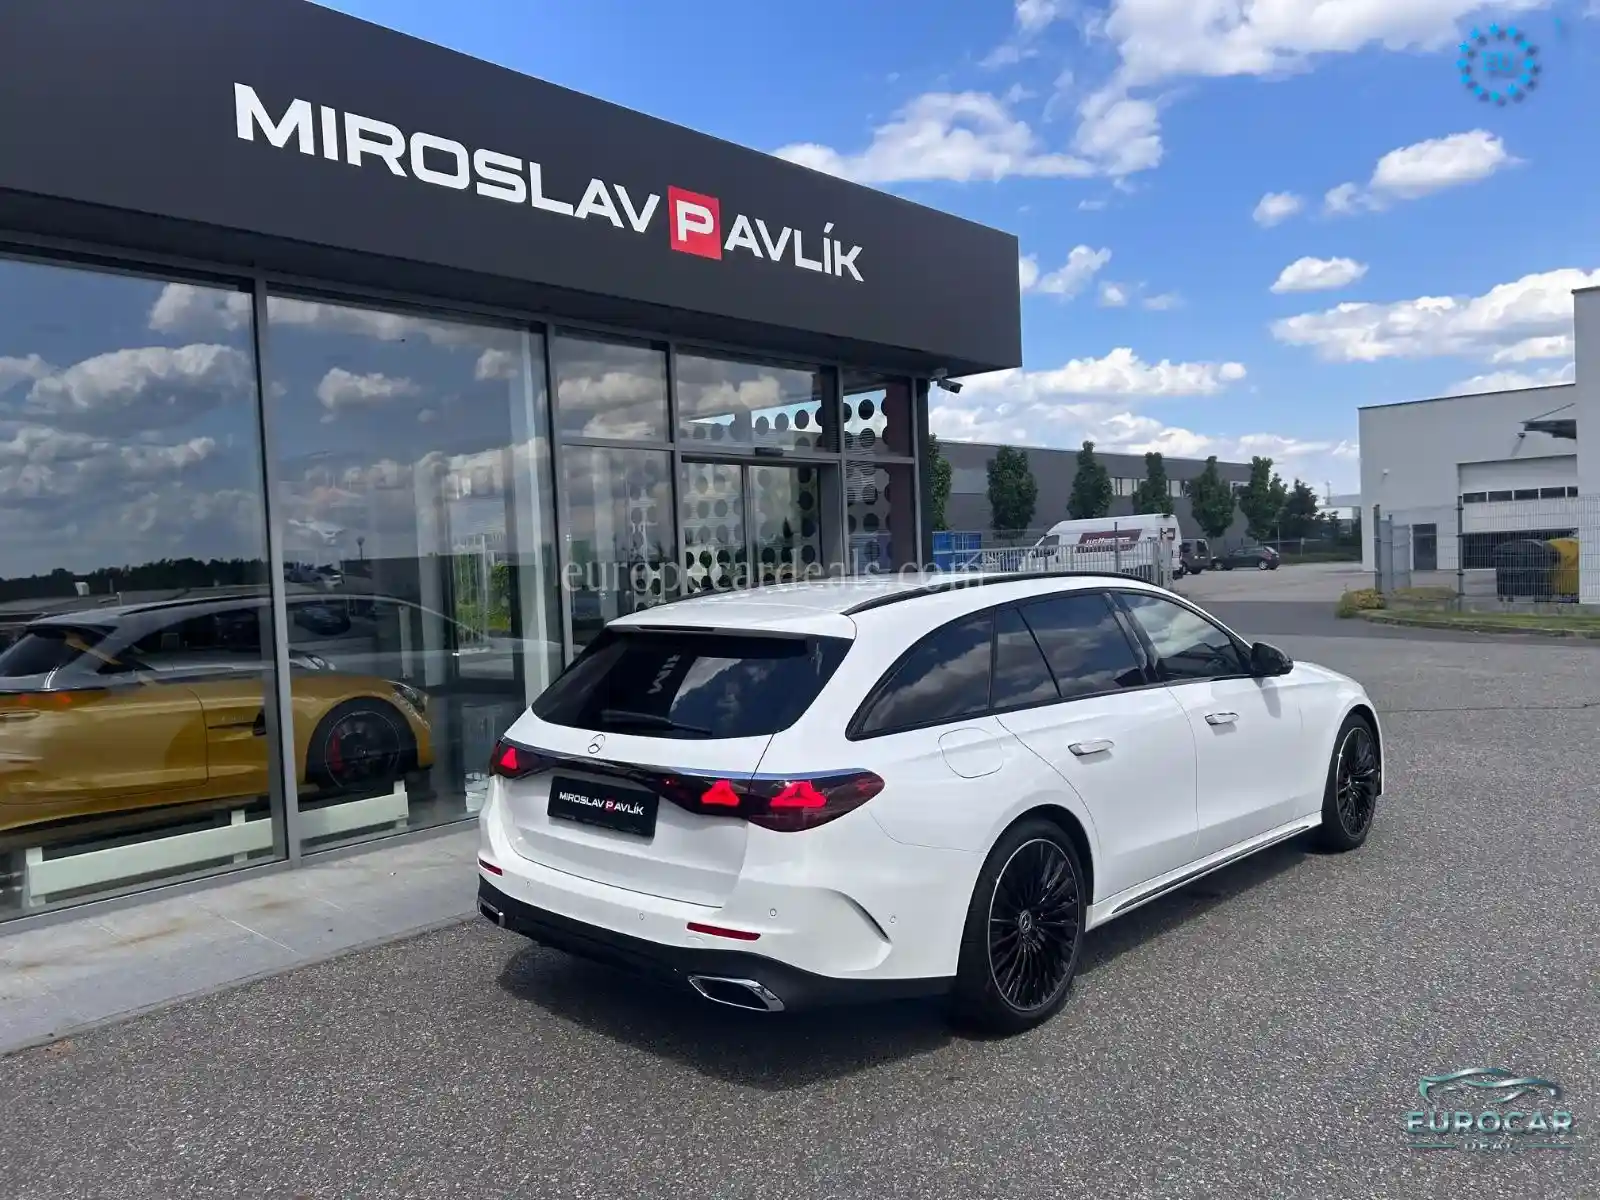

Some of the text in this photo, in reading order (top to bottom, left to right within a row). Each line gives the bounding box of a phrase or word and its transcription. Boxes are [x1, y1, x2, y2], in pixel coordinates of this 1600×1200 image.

[233, 82, 864, 282] MIROSLAV PAVLÍK
[559, 791, 645, 815] MIROSLAV PAVLÍK
